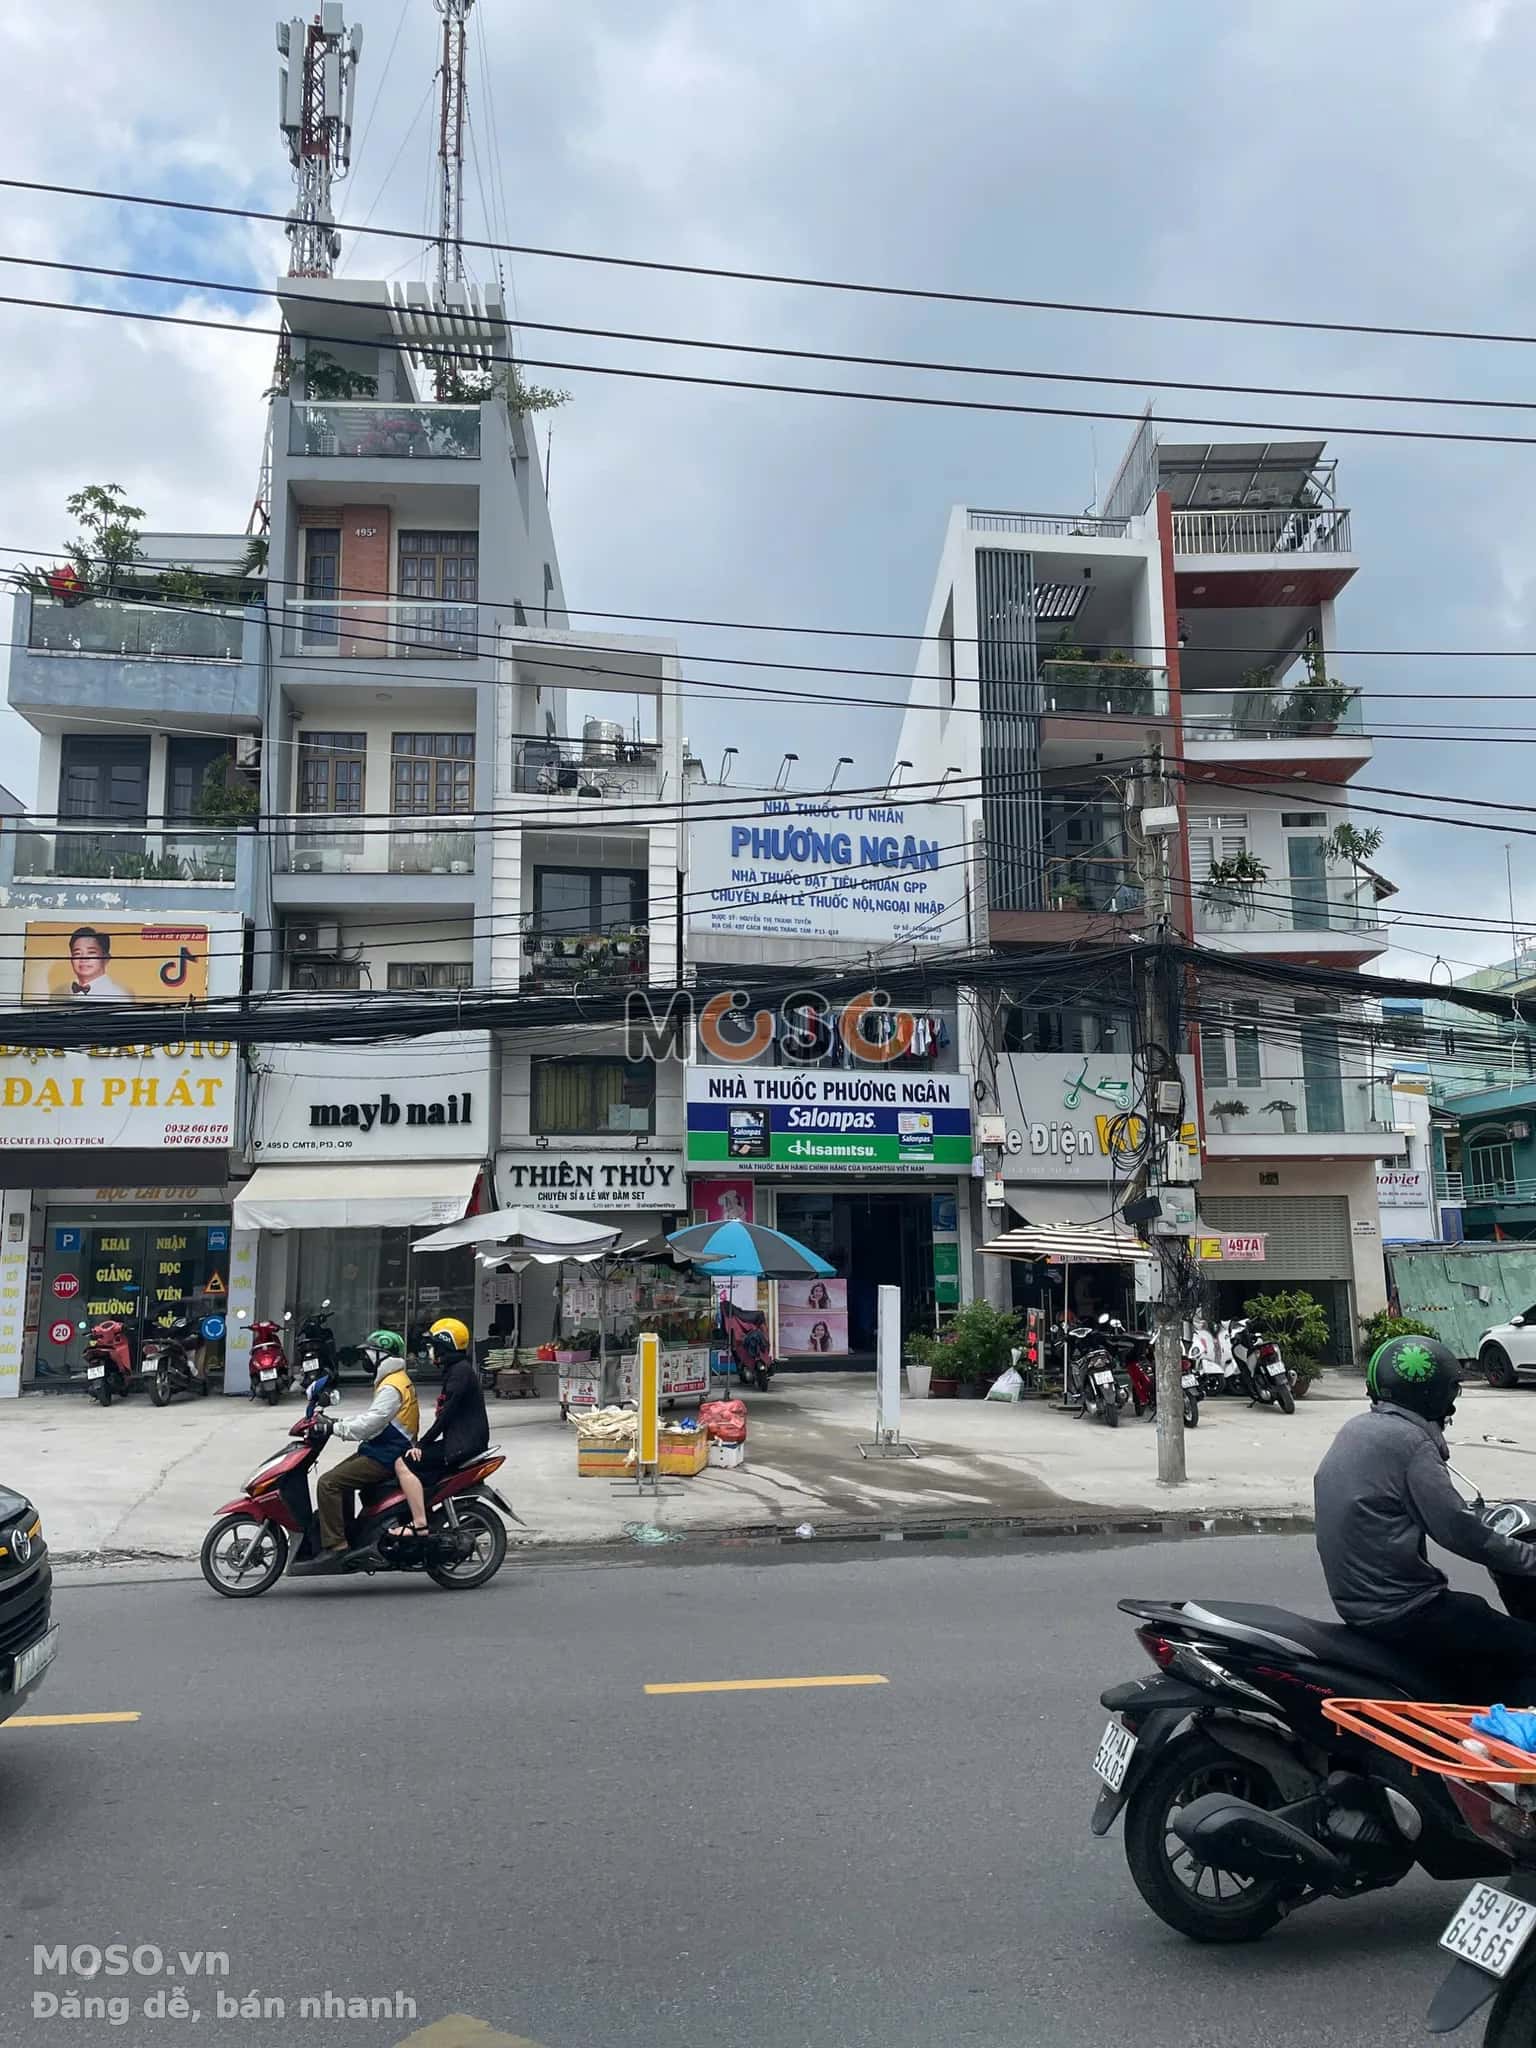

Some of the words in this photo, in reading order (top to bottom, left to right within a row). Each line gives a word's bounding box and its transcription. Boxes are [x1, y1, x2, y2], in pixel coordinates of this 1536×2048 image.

[868, 808, 904, 825] NHÂN
[731, 824, 851, 865] PHƯƠNG
[860, 835, 939, 871] NGÂN
[731, 868, 757, 883] NHÀ
[761, 868, 801, 886] THUỐC
[805, 875, 828, 889] ĐẠT
[903, 882, 928, 894] GPP
[711, 888, 760, 904] CHUYÊN
[763, 889, 788, 906] BÁN
[810, 892, 849, 909] THUỐC
[914, 902, 945, 917] NHẬP
[3, 1077, 85, 1113] ĐẠI
[101, 1069, 224, 1109] PHÁT
[708, 1073, 747, 1099] NHÀ
[754, 1073, 817, 1100] THUỐC
[823, 1078, 896, 1102] PHƯƠNG
[902, 1079, 950, 1103] NGÂN
[309, 1094, 400, 1132] mayb
[407, 1093, 473, 1125] nail
[787, 1107, 876, 1132] Salonpas
[165, 1124, 190, 1133] 0932
[191, 1124, 209, 1133] 661
[210, 1124, 229, 1133] 676
[733, 1128, 762, 1138] Salonpas
[163, 1135, 182, 1145] 090
[184, 1135, 201, 1145] 676
[202, 1135, 229, 1145] 8383
[901, 1134, 930, 1144] Salonpas
[1002, 1128, 1022, 1155] e
[1030, 1122, 1094, 1163] Điện
[788, 1140, 878, 1157] Hisamitsu
[510, 1160, 594, 1188] THIÊN
[600, 1156, 675, 1187] THỦY
[632, 1191, 645, 1201] SET
[62, 1233, 74, 1246] P
[100, 1237, 131, 1251] KHAI
[156, 1234, 187, 1251] NHẬN
[1229, 1238, 1259, 1251] 497A
[96, 1263, 133, 1282] GIẢNG
[159, 1262, 181, 1276] HỌC
[54, 1279, 77, 1291] STOP
[156, 1285, 182, 1301] VIÊN
[87, 1298, 135, 1315] THƯỜNG
[55, 1326, 68, 1337] 20
[1446, 1917, 1514, 1968] 645.65
